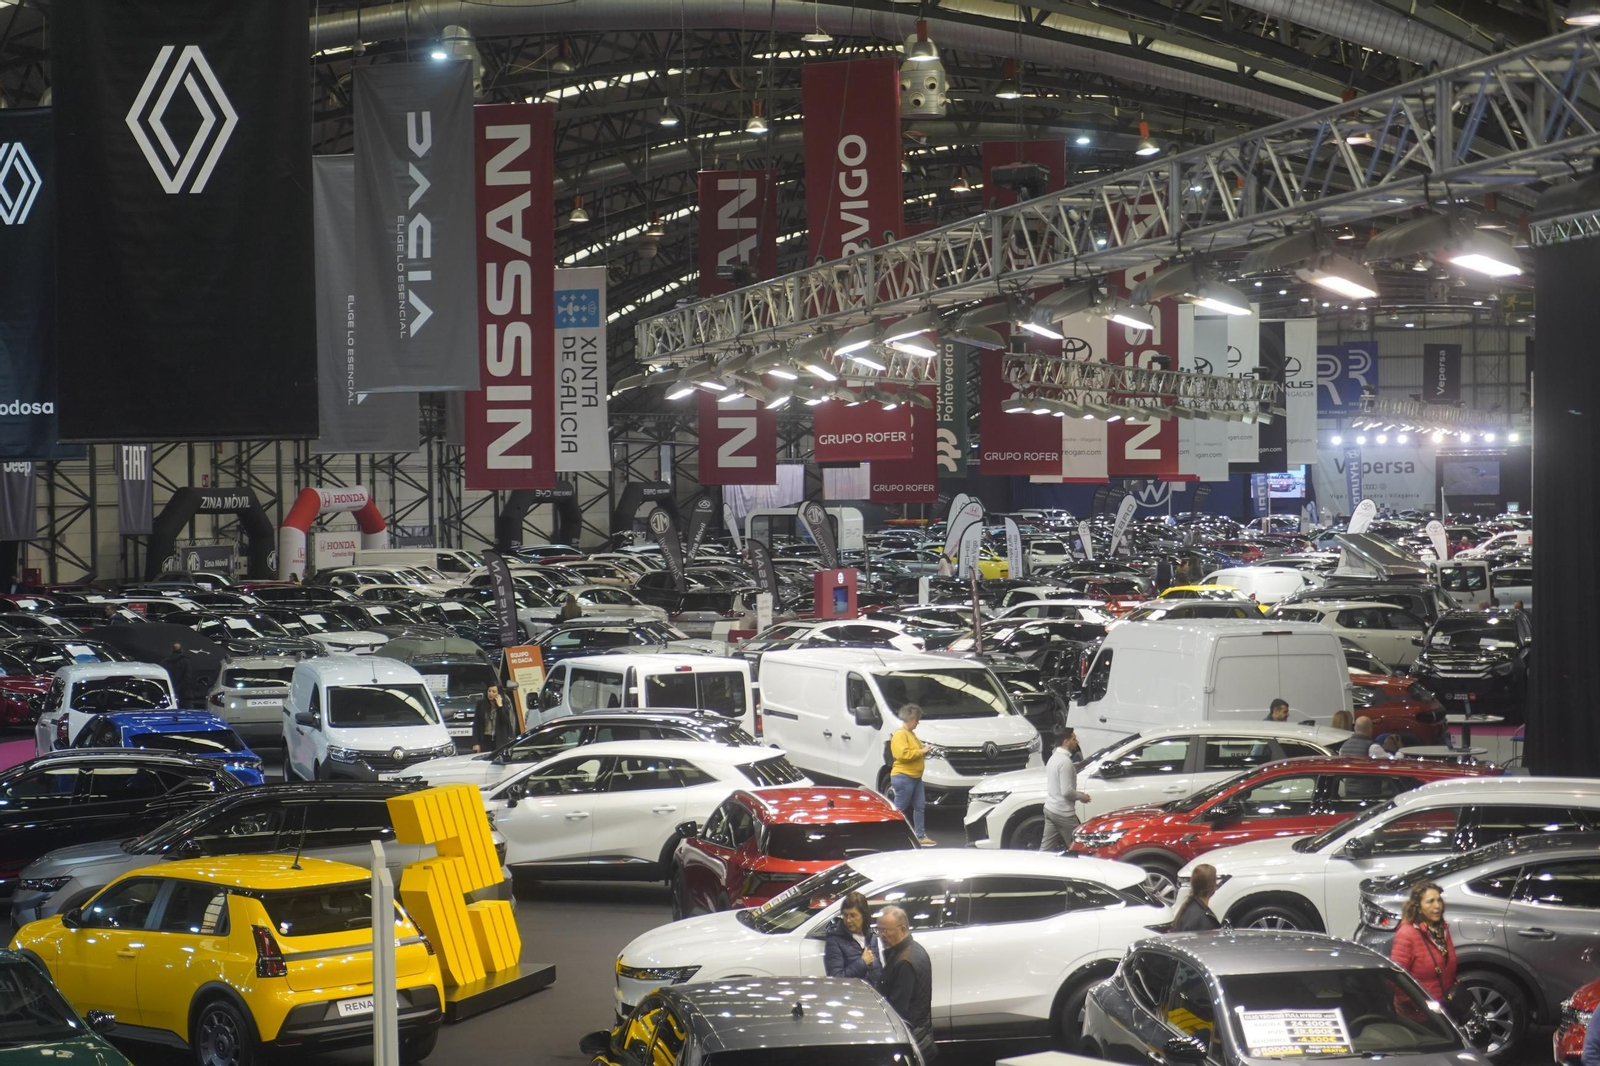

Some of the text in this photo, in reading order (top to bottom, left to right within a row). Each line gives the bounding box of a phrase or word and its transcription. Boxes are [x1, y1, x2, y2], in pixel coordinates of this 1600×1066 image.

[396, 215, 407, 339] ELIGE LO ESENCIAL
[485, 123, 533, 470] NISSAN
[347, 295, 355, 405] ELIGE LO ESENCIAL
[580, 335, 599, 408] XUNTA
[1436, 350, 1446, 395] Vepersa
[943, 343, 954, 421] Pontevedra
[1285, 380, 1314, 389] XUS
[560, 335, 578, 454] DE GALICIA
[0, 399, 54, 416] odosa
[818, 431, 907, 445] GRUPO ROFER
[984, 452, 1059, 461] GRUPO ROFER
[1062, 449, 1102, 457] reogan.com
[1196, 452, 1222, 460] gan.com
[1259, 446, 1282, 454] gan.com
[122, 445, 147, 480] FIAT
[1333, 458, 1415, 479] Vpersa
[535, 489, 551, 497] BYD
[873, 483, 935, 492] GRUPO ROFER
[200, 496, 222, 509] ZINA
[333, 493, 366, 503] HONDA
[1114, 503, 1135, 538] EBRO
[326, 541, 356, 550] HONDA
[204, 559, 215, 568] Zina
[344, 1000, 374, 1012] RENA
[1260, 1046, 1301, 1054] RODOSA
